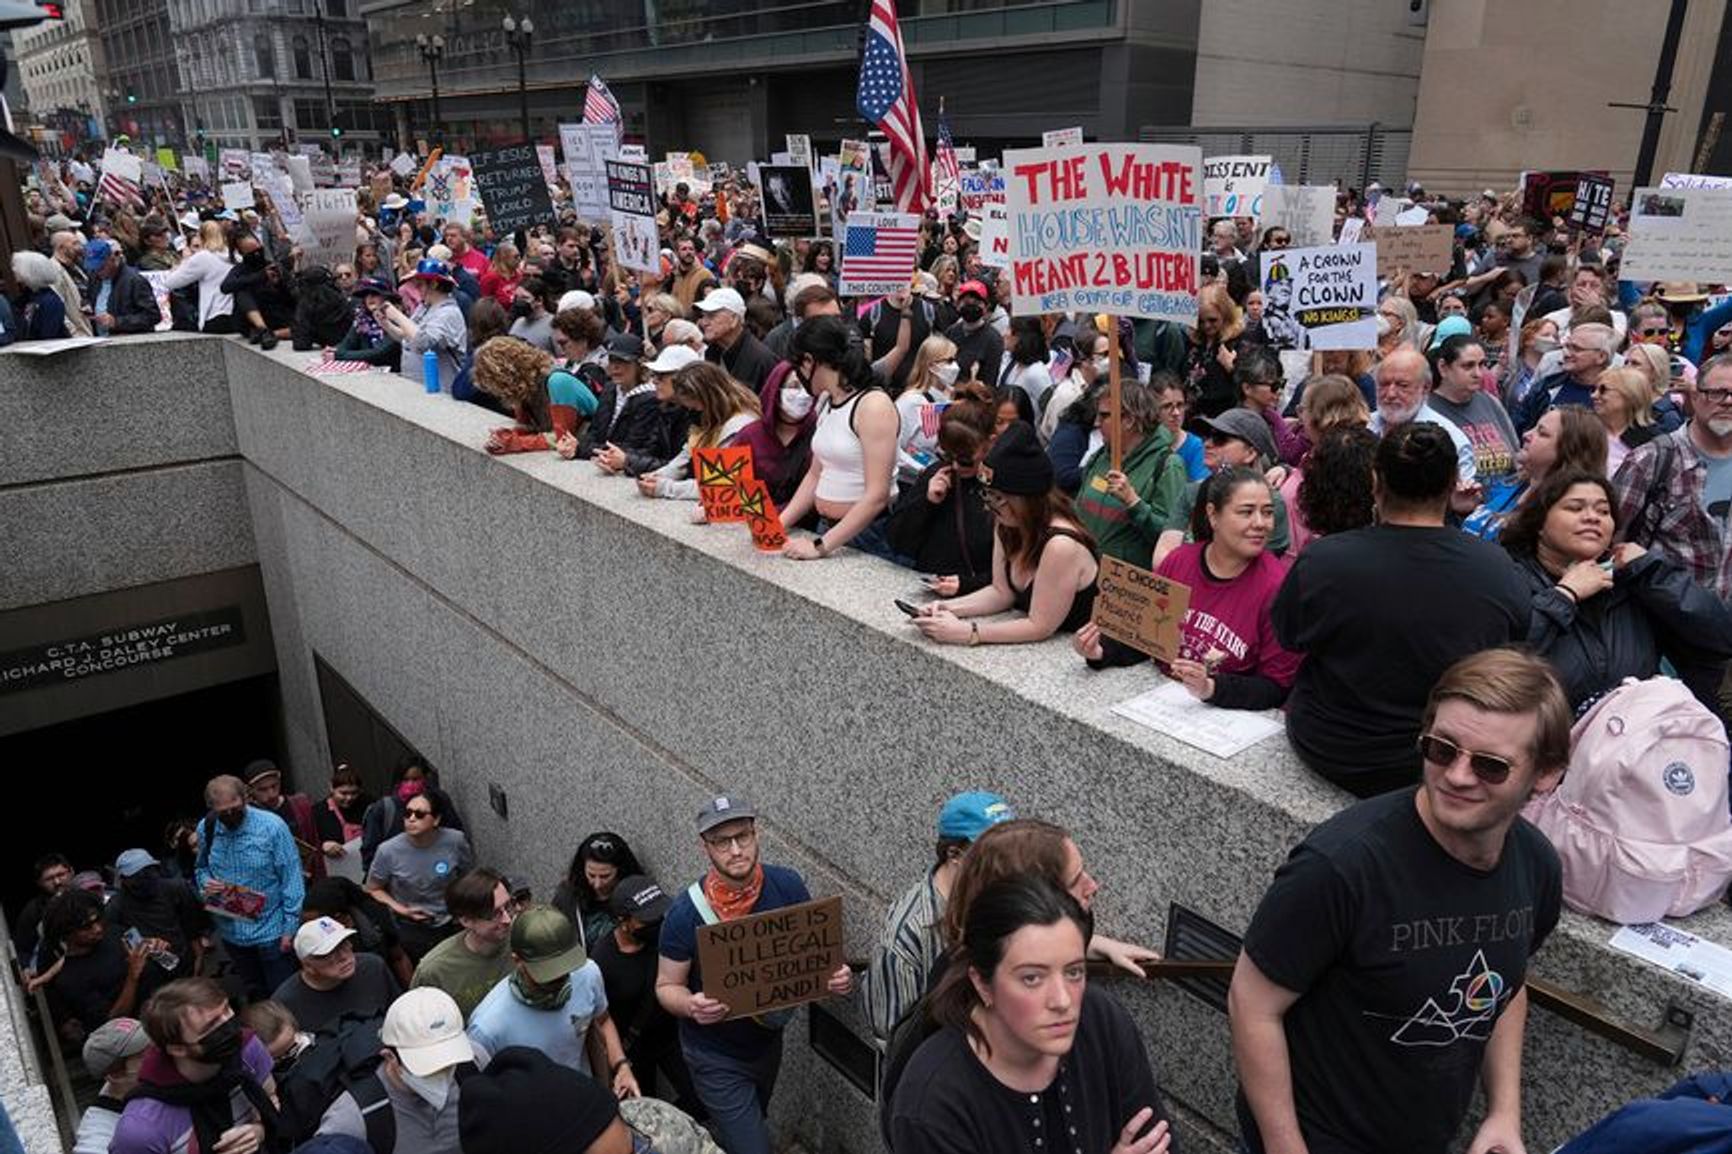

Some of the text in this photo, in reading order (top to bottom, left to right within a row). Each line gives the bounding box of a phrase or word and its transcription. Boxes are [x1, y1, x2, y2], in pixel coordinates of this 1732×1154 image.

[470, 153, 492, 168] IF
[477, 166, 541, 186] RETURNED
[1014, 152, 1194, 204] THE WHITE
[1224, 178, 1234, 192] is
[485, 183, 532, 200] TRUMP
[612, 190, 652, 214] AMERICA
[878, 218, 899, 228] LOVE
[1018, 208, 1107, 257] HOUSE
[1298, 251, 1362, 272] A CROWN
[1014, 252, 1198, 297] MEANT 2 B LITERAL
[1308, 269, 1353, 285] FOR THE
[847, 283, 865, 293] THIS
[1299, 283, 1364, 306] CLOWN
[1303, 311, 1319, 323] NO
[702, 488, 737, 503] NO
[1110, 560, 1124, 578] I
[48, 622, 178, 658] C.T.A. SUBWAY
[1194, 612, 1219, 635] THE
[1213, 621, 1249, 660] STARS
[1, 624, 232, 680] ICHARD J. DALEY CENTER
[64, 645, 174, 678] CONCOURSE
[709, 906, 829, 946] NO ONE IS
[1389, 916, 1465, 952] PINK
[728, 927, 840, 967] ILLEGAL
[723, 950, 831, 990] ON STOLEN
[756, 976, 821, 1008] LAND!
